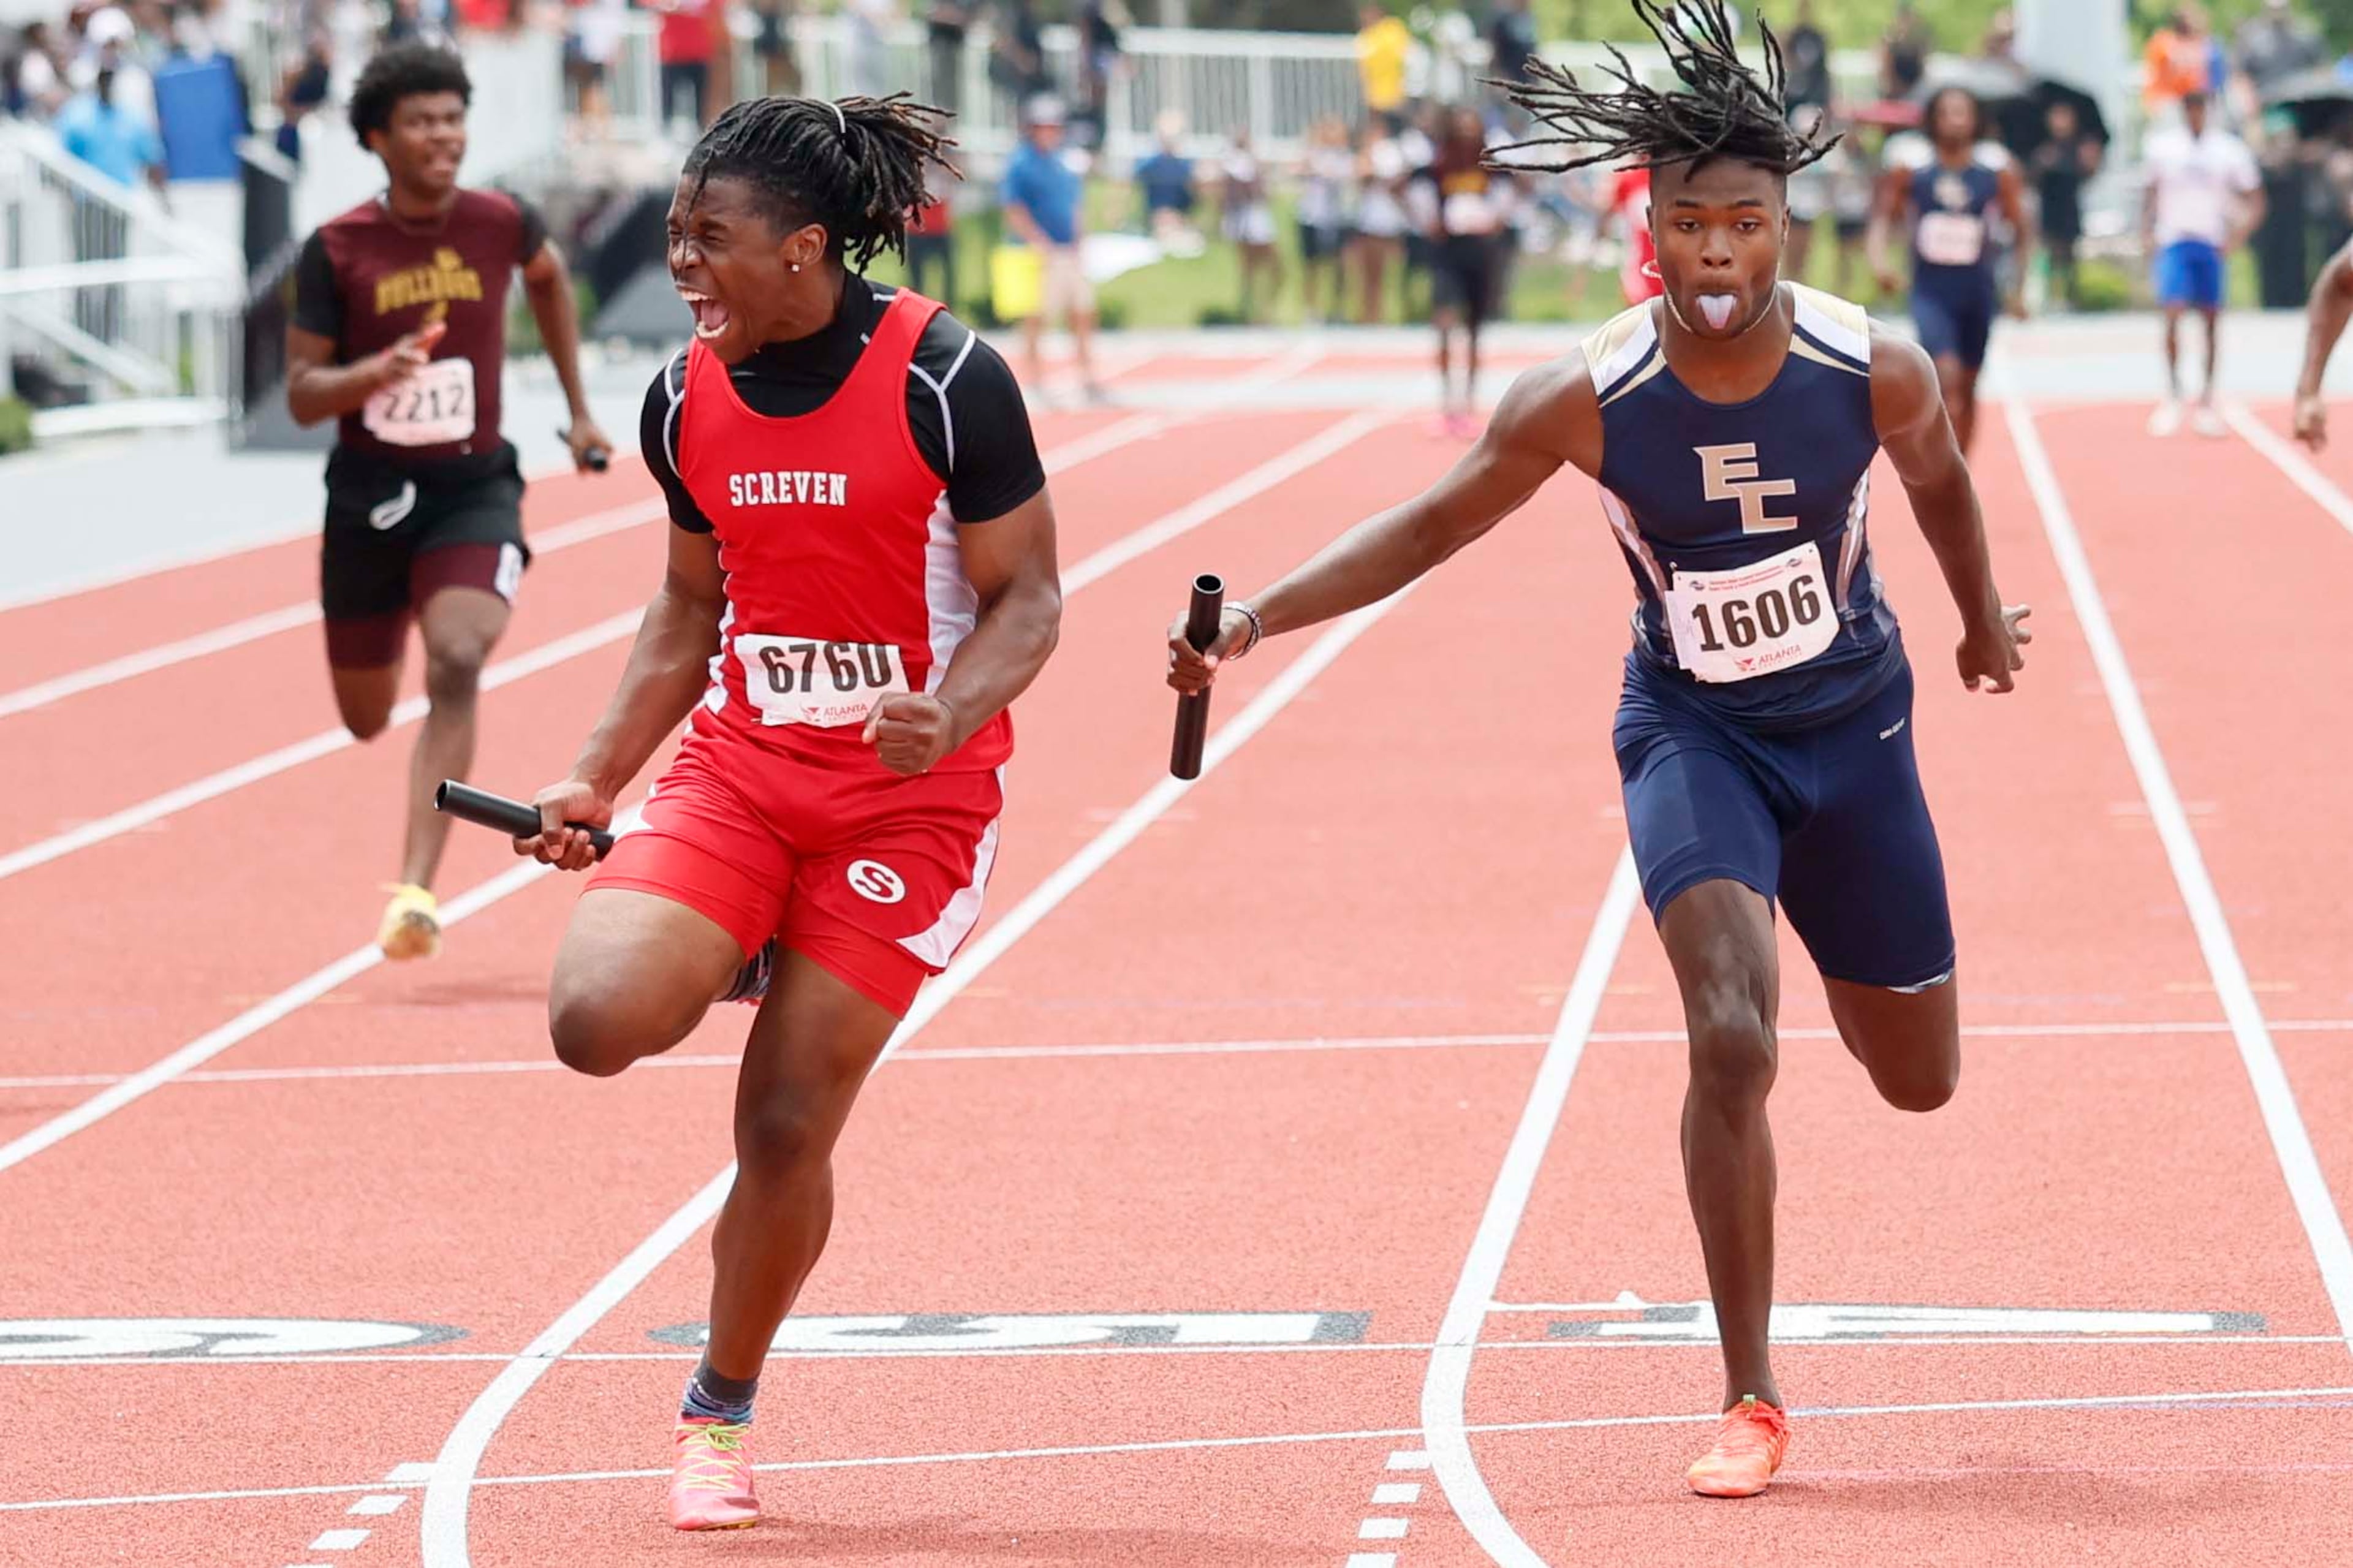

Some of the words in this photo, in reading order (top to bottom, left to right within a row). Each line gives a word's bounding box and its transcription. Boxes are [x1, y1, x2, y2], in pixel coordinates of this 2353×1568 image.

[385, 384, 465, 422] 2212
[729, 471, 848, 507] SCREVEN
[1693, 442, 1798, 534] EC
[1691, 574, 1822, 653] 1606
[758, 642, 893, 694] 6760
[1758, 645, 1802, 664] ATLANTA
[824, 703, 868, 716] ATLANTA
[854, 865, 896, 899] S
